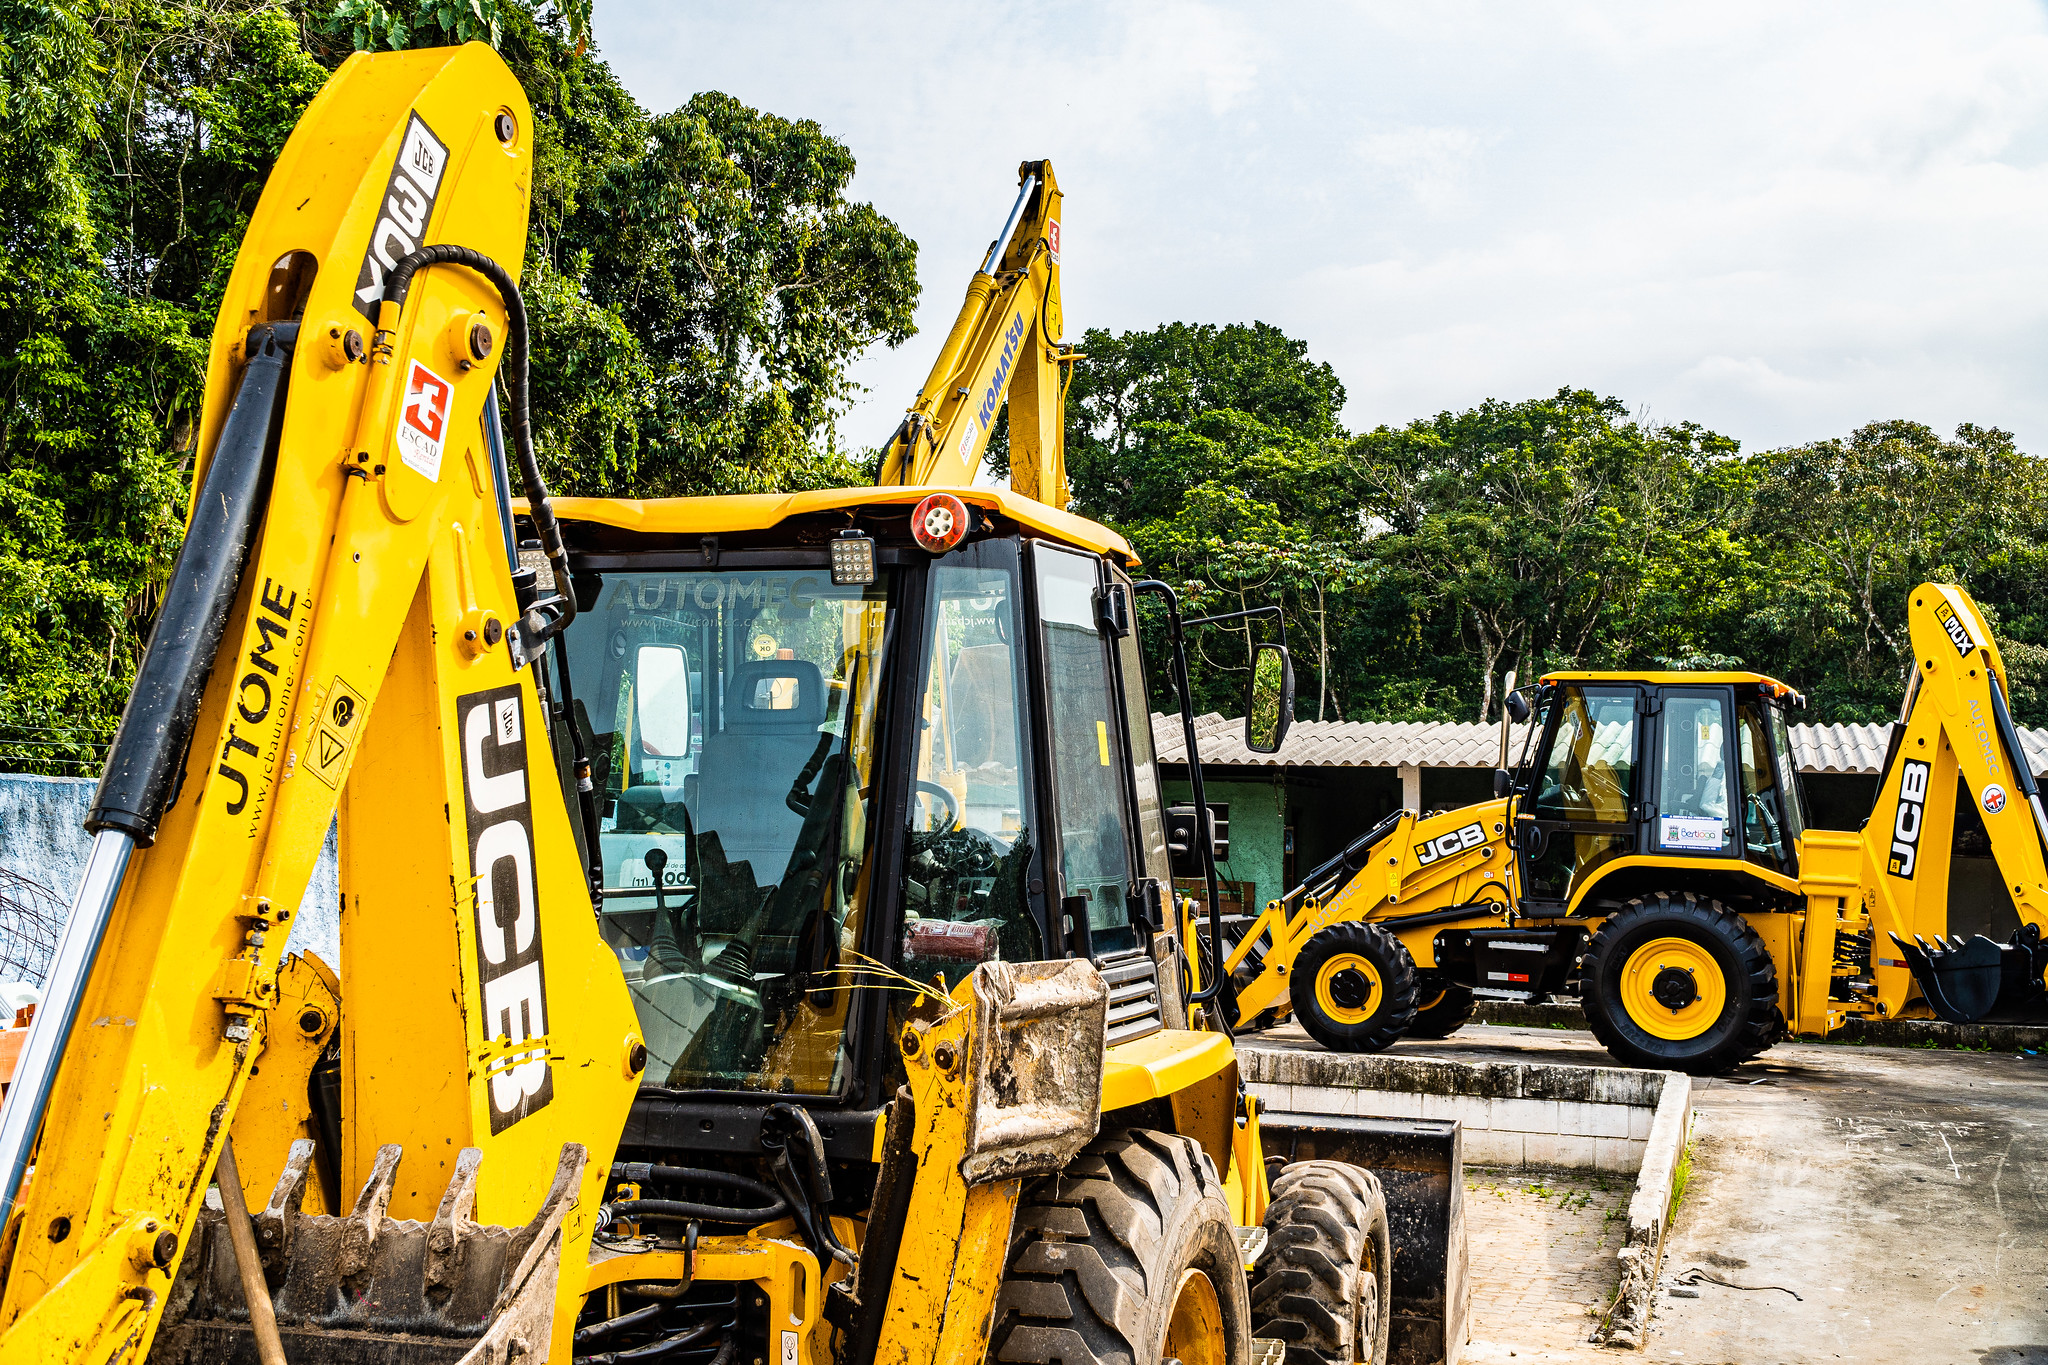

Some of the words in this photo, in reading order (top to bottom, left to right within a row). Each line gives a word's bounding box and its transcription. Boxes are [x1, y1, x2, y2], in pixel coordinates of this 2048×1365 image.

[414, 139, 434, 175] JCB
[978, 311, 1024, 431] KOMATSU
[401, 425, 438, 458] ESCAD
[606, 576, 819, 611] AUTOMEC
[502, 709, 513, 738] JCB
[1968, 699, 2000, 776] AUTOMEC
[1681, 828, 1716, 840] Bertioga
[1892, 763, 1928, 876] JCB
[1418, 823, 1486, 865] JCB
[464, 702, 547, 1113] JCB
[1308, 878, 1362, 934] AUTOMEC
